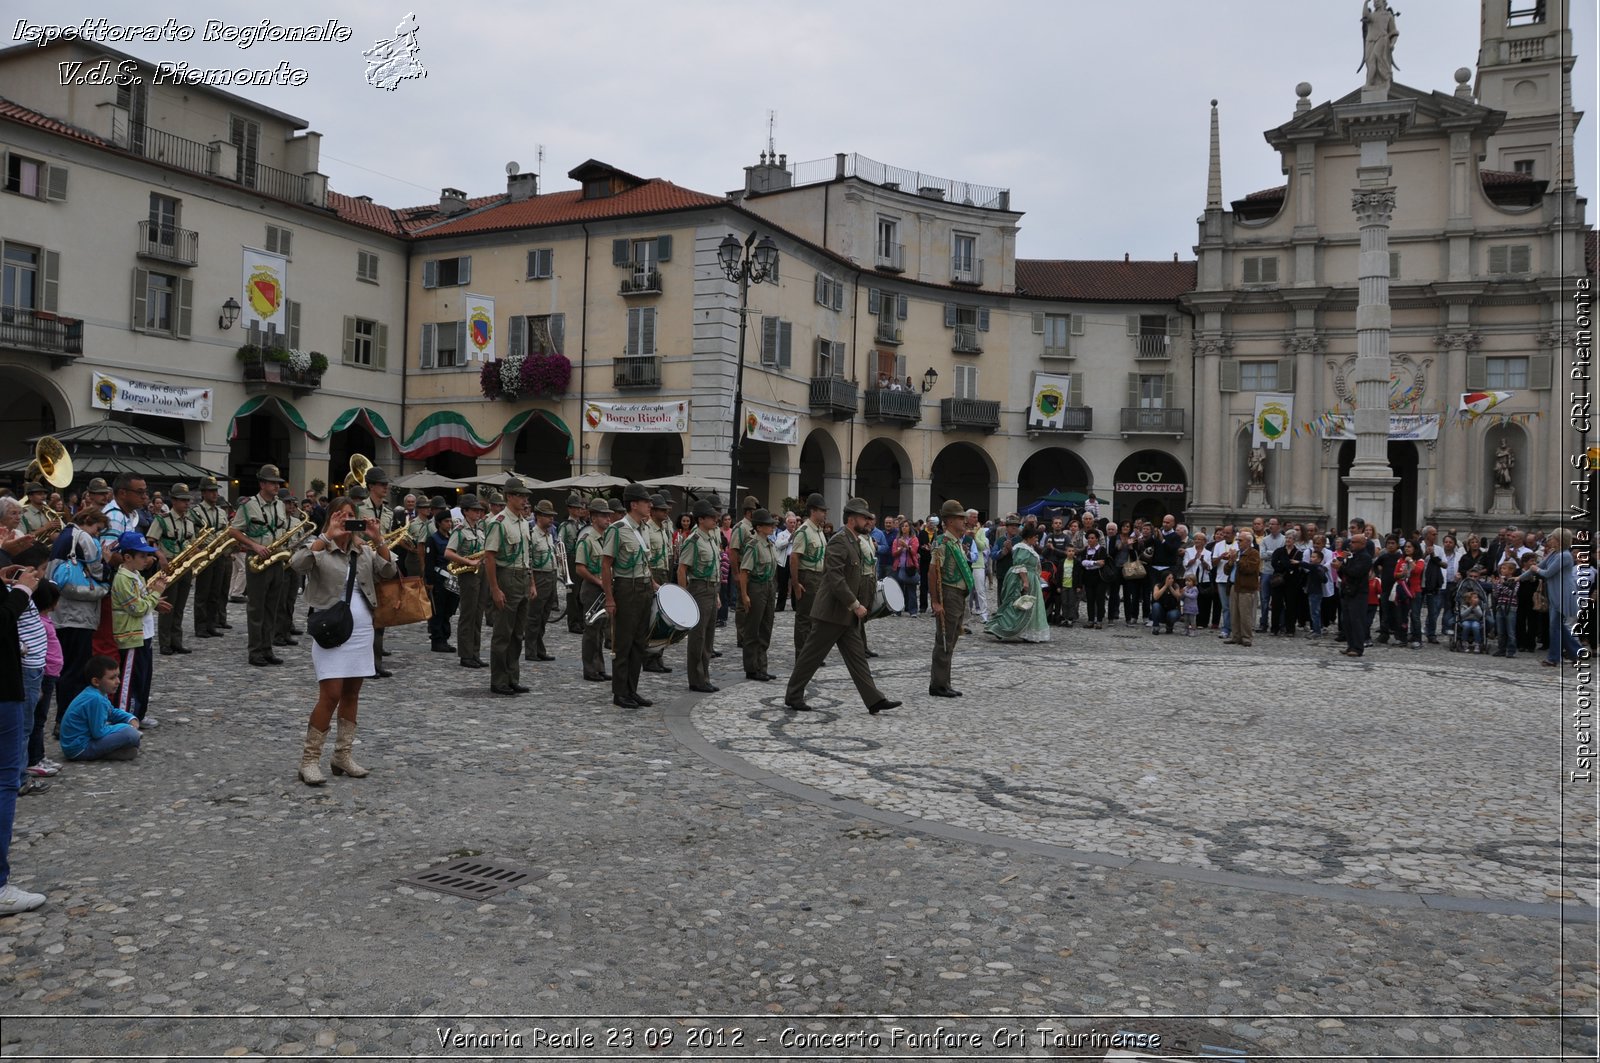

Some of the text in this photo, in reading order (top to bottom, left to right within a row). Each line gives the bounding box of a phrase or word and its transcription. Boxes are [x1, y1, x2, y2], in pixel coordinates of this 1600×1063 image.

[121, 389, 196, 409] Borgo Polo Nord
[605, 413, 671, 425] Borgo Rigola
[1117, 483, 1183, 492] FOTO OTTICA
